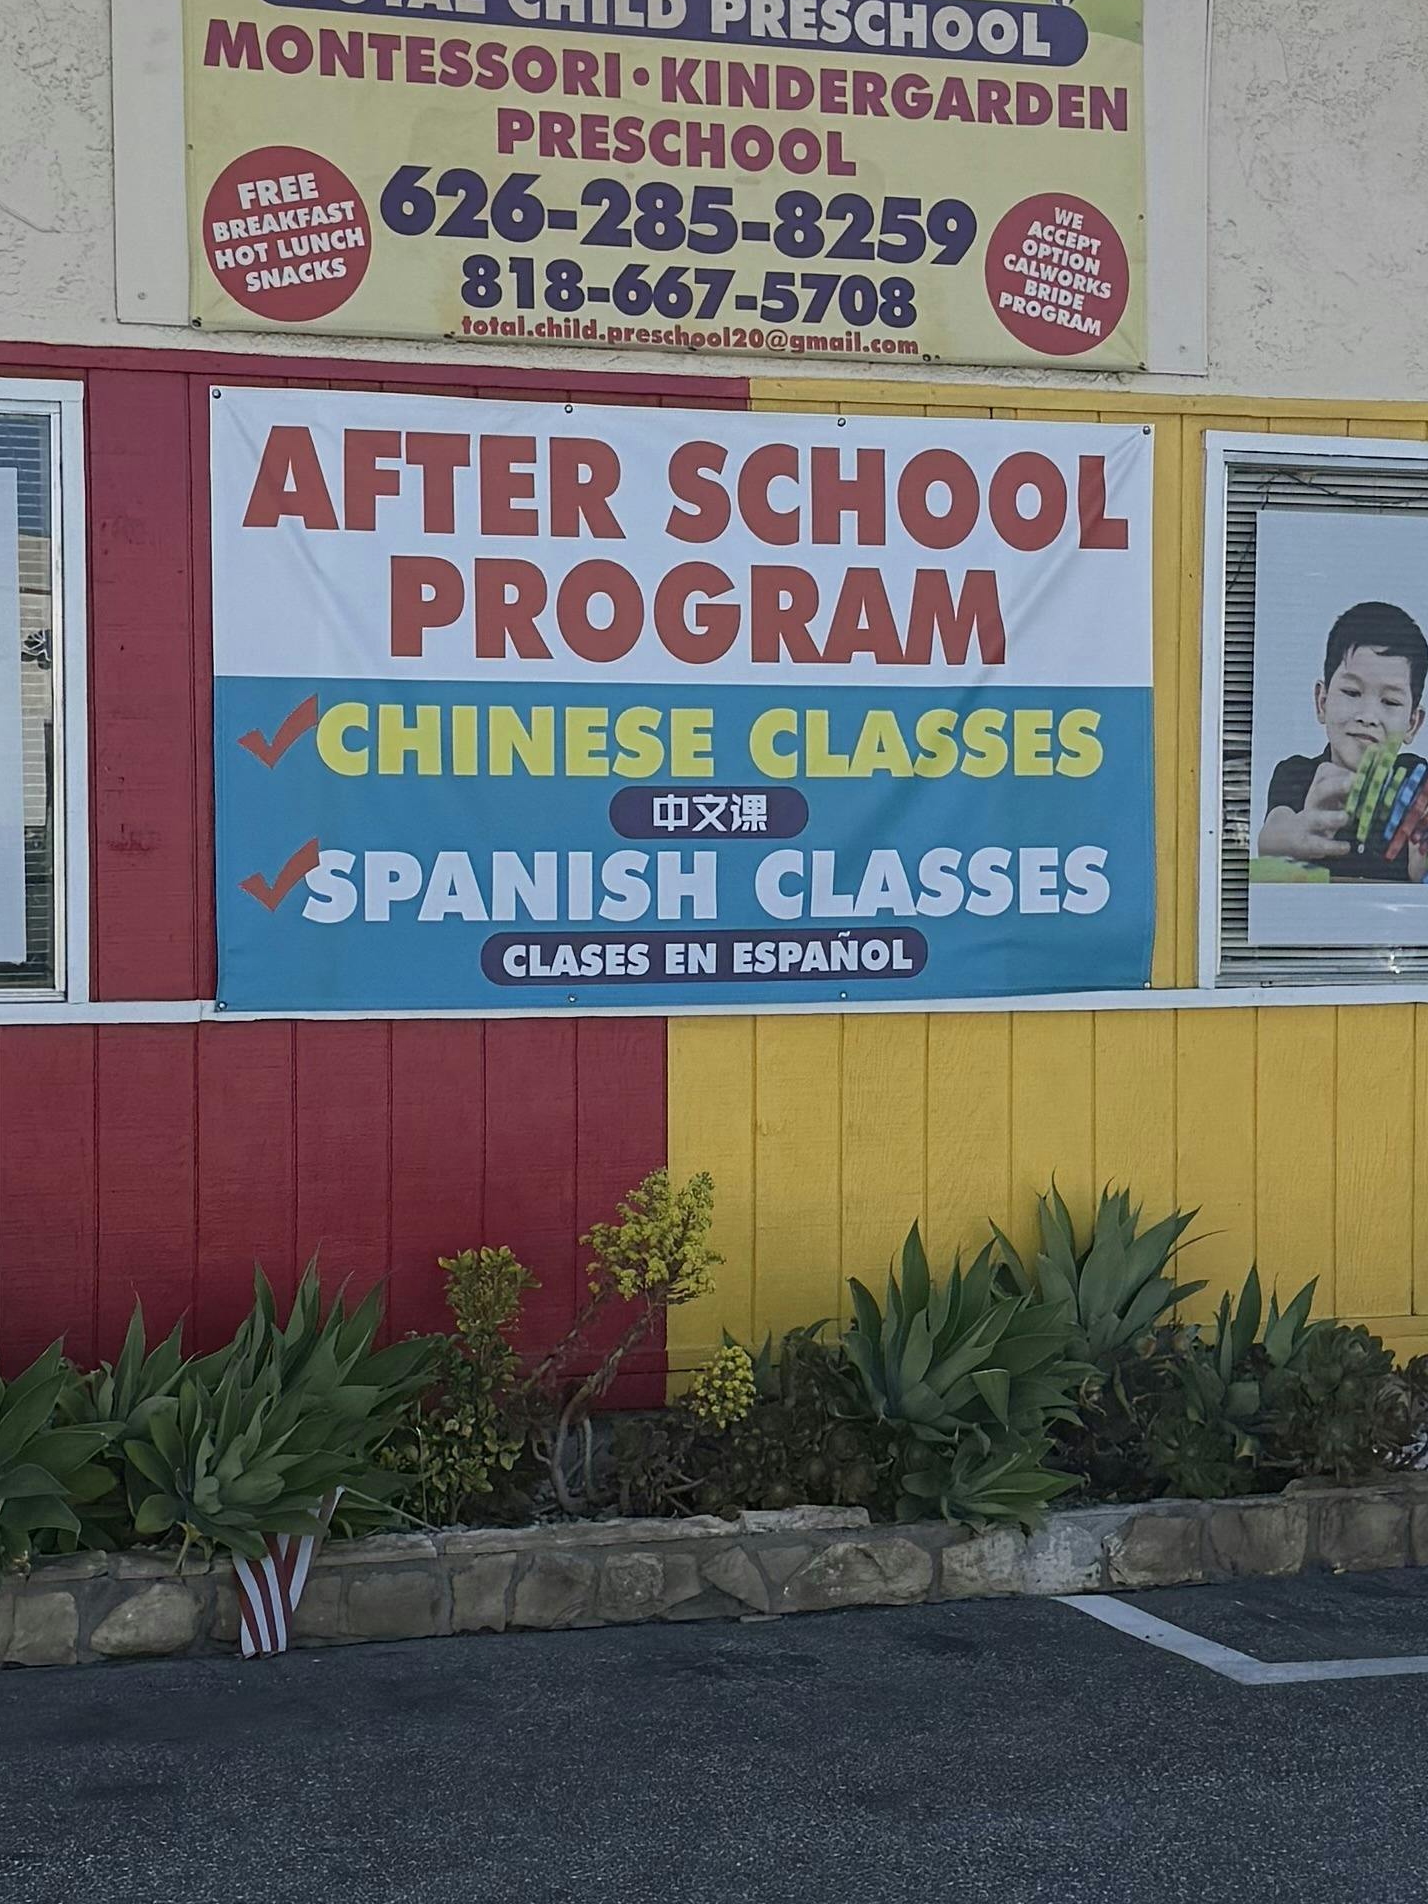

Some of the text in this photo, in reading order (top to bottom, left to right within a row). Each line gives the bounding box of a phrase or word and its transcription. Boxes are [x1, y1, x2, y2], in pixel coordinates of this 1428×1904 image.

[203, 18, 1129, 132] MONTESSORI KINDERGARDEN
[496, 107, 857, 177] PRESCHOOL
[237, 172, 319, 210] FREE
[212, 200, 356, 243] BREAKFAST
[379, 163, 978, 267] 626-285-8259
[1027, 220, 1102, 255] ACCEPT
[1054, 206, 1084, 230] WE
[214, 226, 366, 270] HOT LUNCH
[1022, 239, 1101, 276] OPTION
[245, 257, 348, 293] SNACKS
[461, 253, 918, 328] 818-667-5708
[1003, 253, 1112, 299] CALWORKS
[1024, 279, 1085, 311] BRIDE
[461, 315, 920, 356] total.child.preschool20@gmail.com
[998, 291, 1102, 336] PROGRAM
[241, 425, 1131, 552] AFTER SCHOOL
[389, 553, 1007, 666] PROGRAM
[316, 701, 1105, 779] CHINESE CLASSES
[652, 793, 768, 832] 中文课
[301, 845, 1111, 924] SPANISH CLASSES
[502, 930, 913, 978] CLASES EN ESPAÑOL
